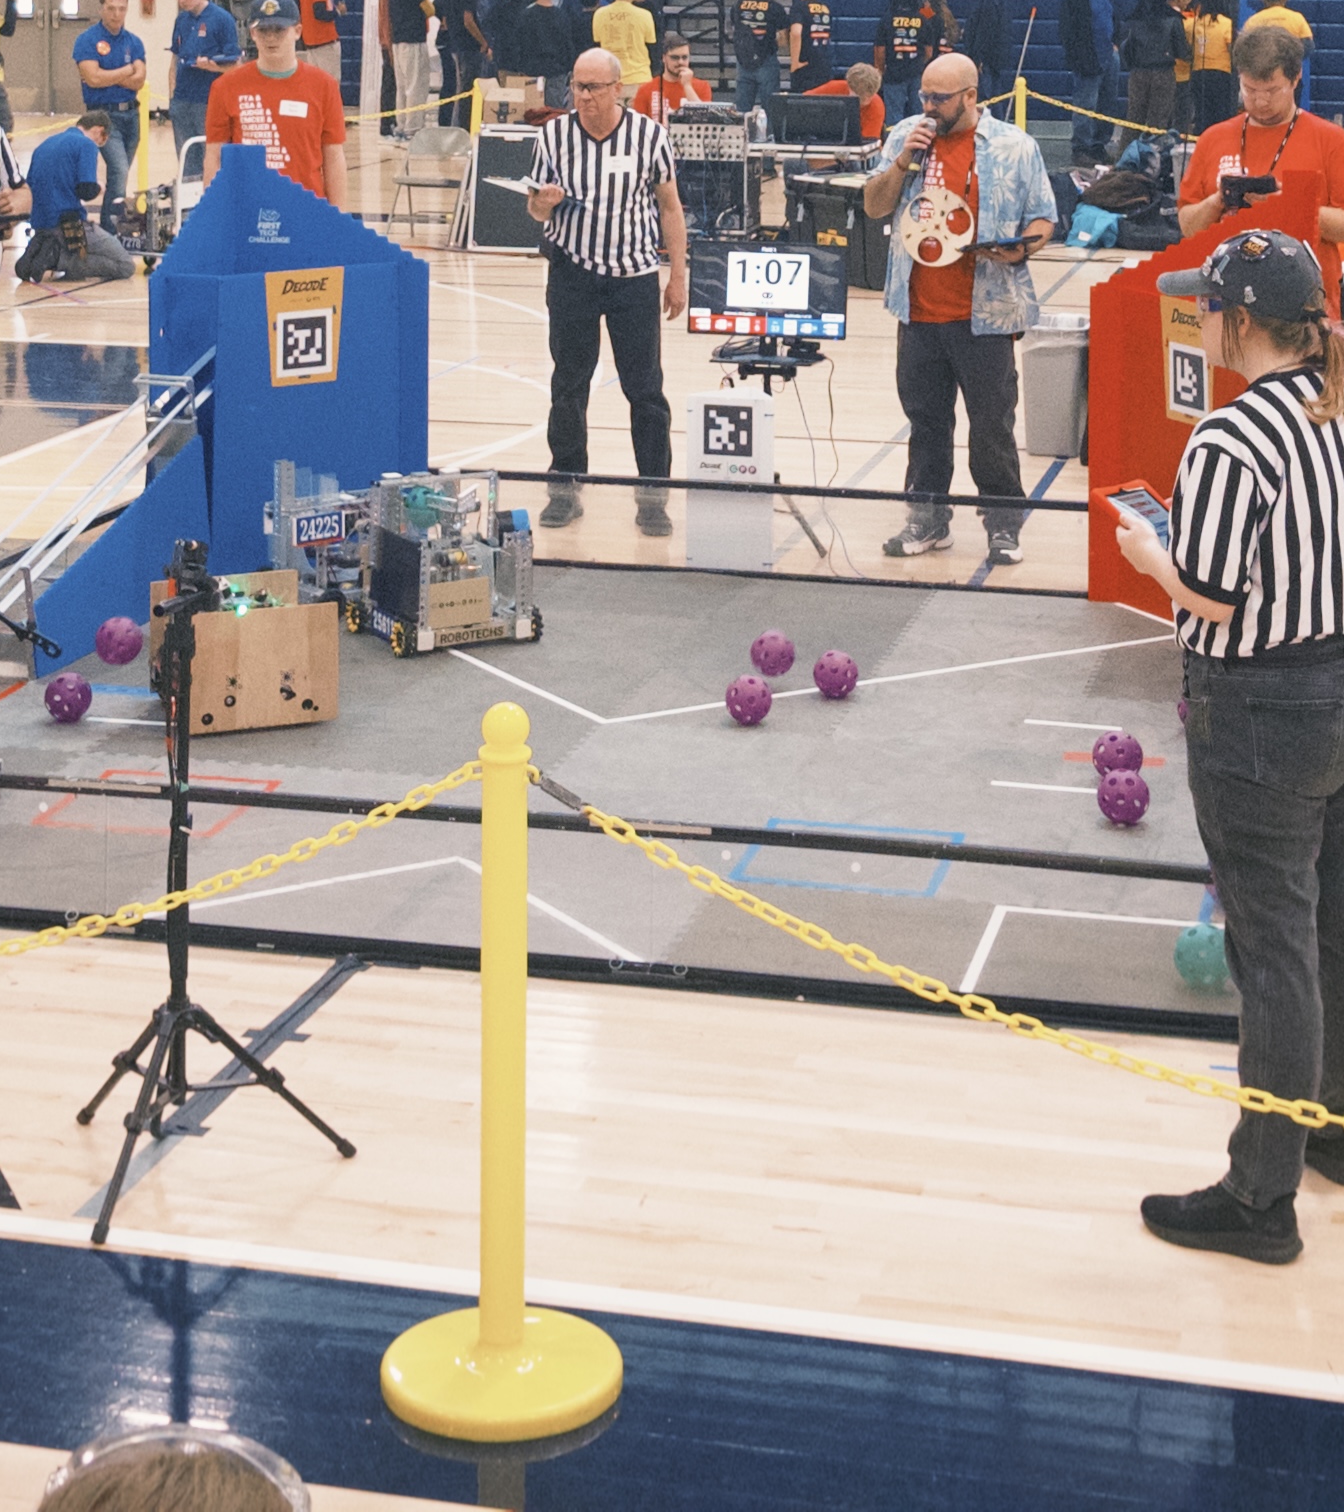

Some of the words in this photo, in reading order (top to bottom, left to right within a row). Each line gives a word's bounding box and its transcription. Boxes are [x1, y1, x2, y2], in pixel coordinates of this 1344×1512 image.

[257, 222, 281, 230] FIRST
[248, 236, 291, 244] CHALLENGE
[736, 259, 803, 285] 1:07
[281, 277, 330, 295] DECODE
[300, 515, 339, 541] 24225
[440, 626, 504, 644] ROBOTECHS
